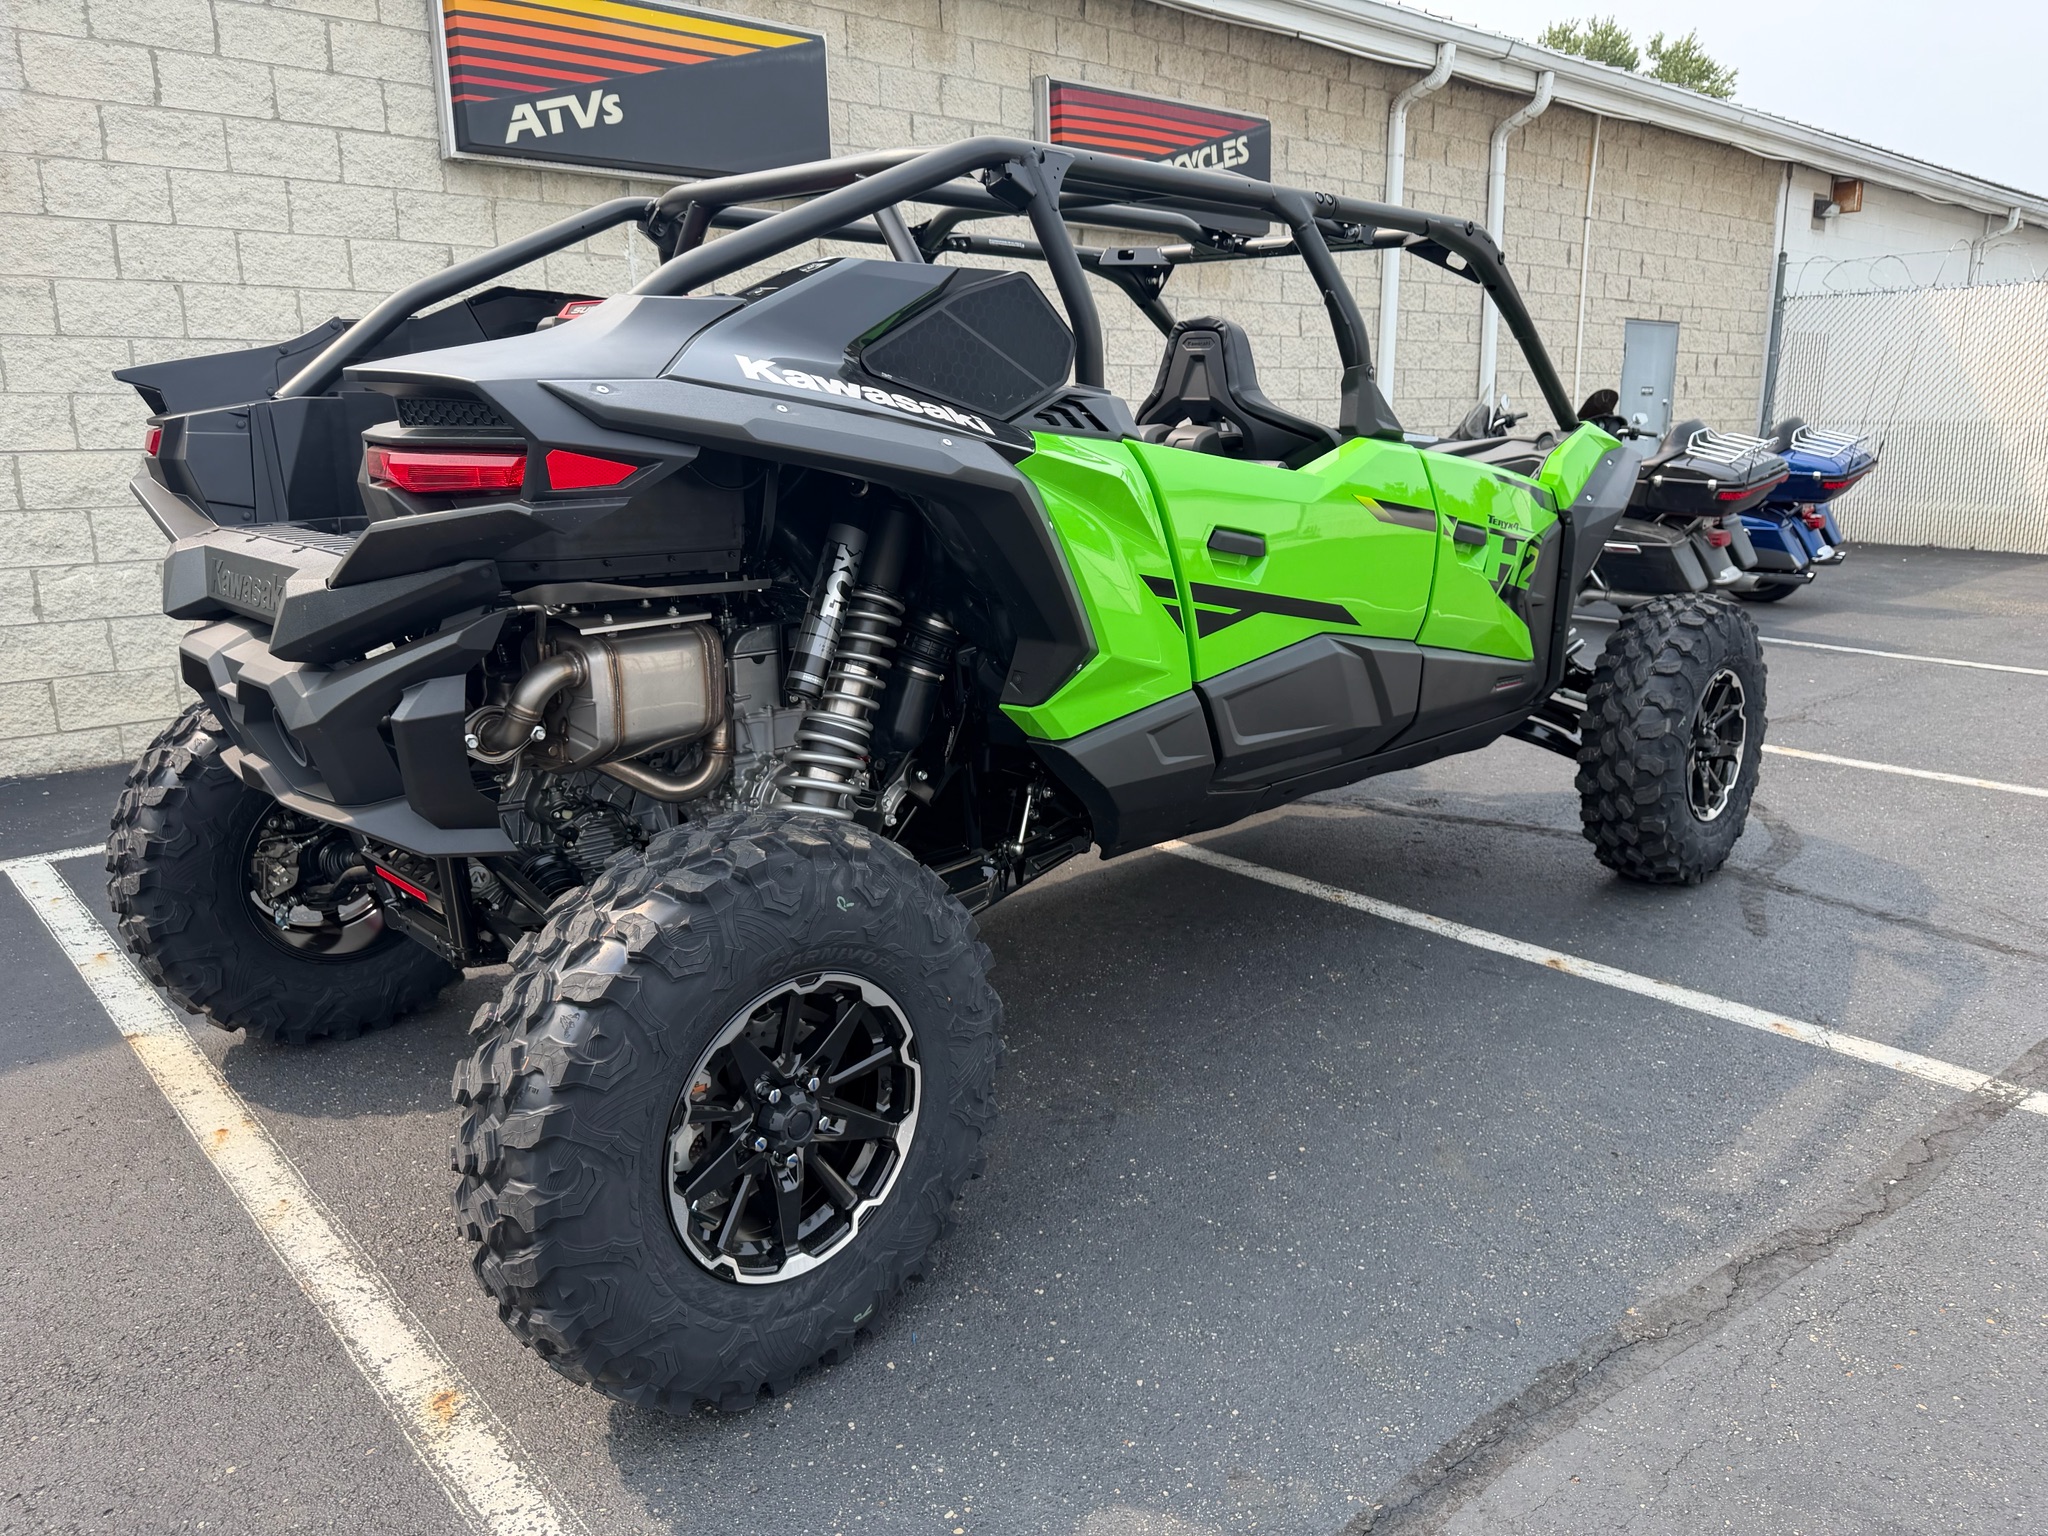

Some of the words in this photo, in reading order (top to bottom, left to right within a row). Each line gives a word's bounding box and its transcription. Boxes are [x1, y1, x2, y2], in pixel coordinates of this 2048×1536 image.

[505, 89, 624, 144] ATVs
[1158, 135, 1250, 169] CYCLES
[734, 354, 996, 436] Kawasaki
[820, 543, 862, 619] FOX
[1484, 533, 1540, 591] H2
[769, 946, 904, 979] CARNIVORE
